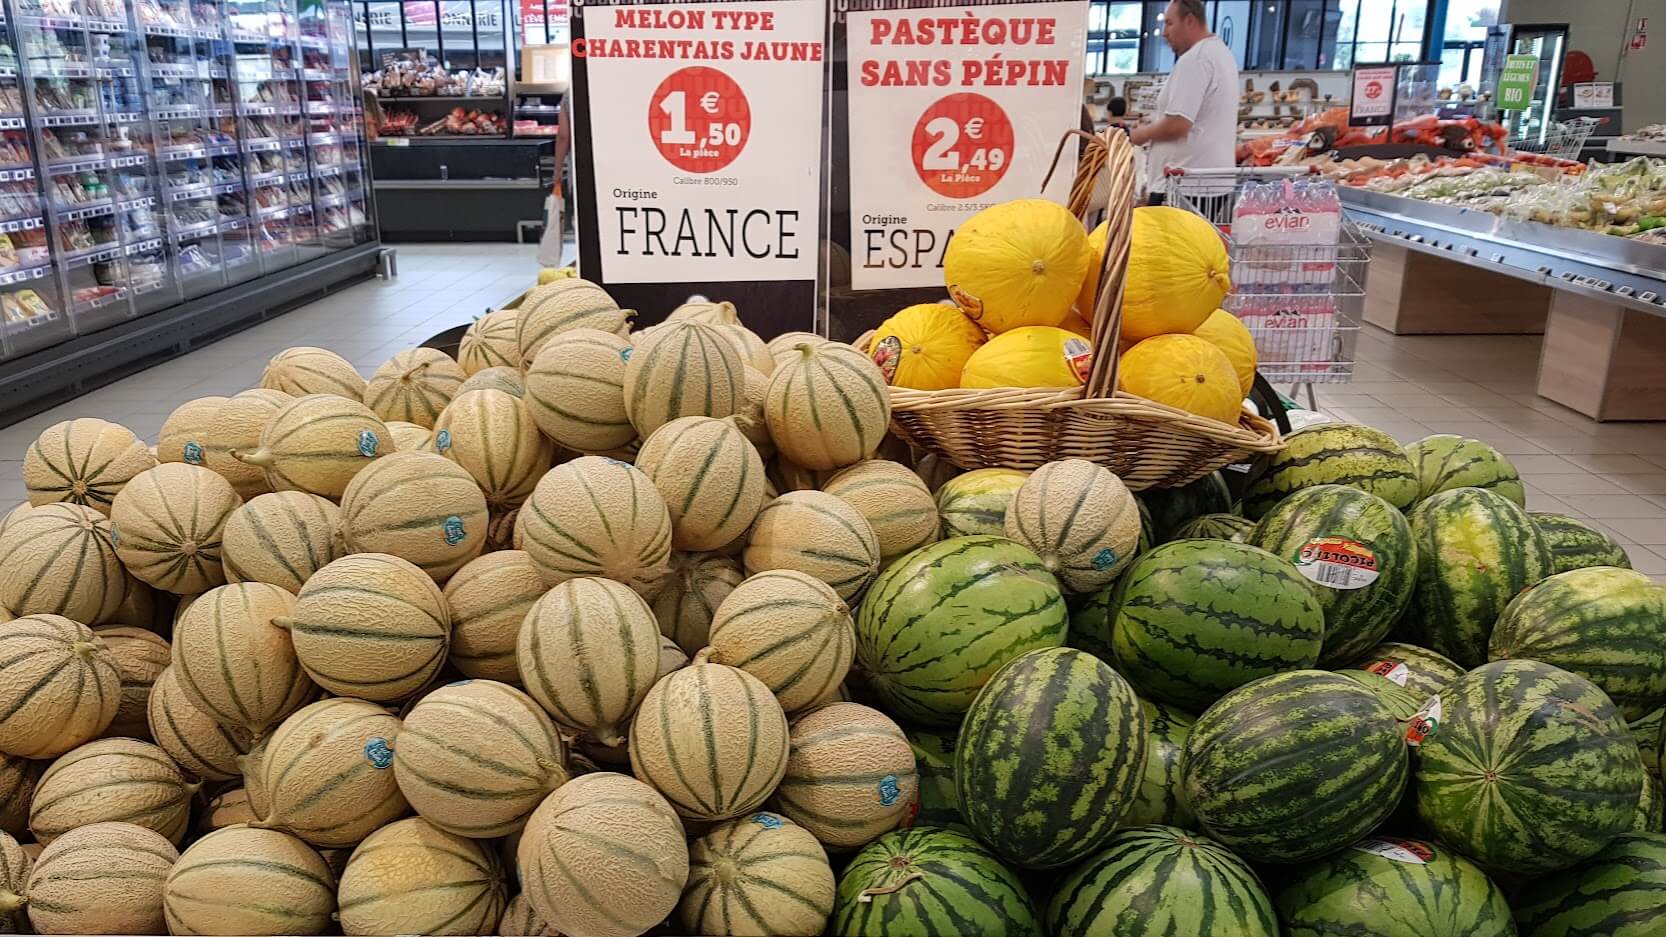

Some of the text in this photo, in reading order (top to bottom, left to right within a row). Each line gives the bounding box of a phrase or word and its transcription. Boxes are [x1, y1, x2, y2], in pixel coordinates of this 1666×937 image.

[615, 9, 774, 31] MELON TYPE
[870, 11, 1056, 45] PASTÈQUE
[571, 38, 822, 62] CHARENTAIS JAUNE
[861, 53, 1069, 87] SANS PÉPIN
[1504, 87, 1523, 102] BIO
[680, 148, 691, 157] La
[673, 176, 738, 186] Calibre 800/950
[941, 174, 953, 182] La
[613, 188, 658, 200] Origine
[927, 203, 956, 212] Calibre
[862, 214, 908, 226] Origine
[1264, 214, 1310, 229] evian
[615, 207, 799, 259] FRANCE
[1264, 316, 1308, 328] evian
